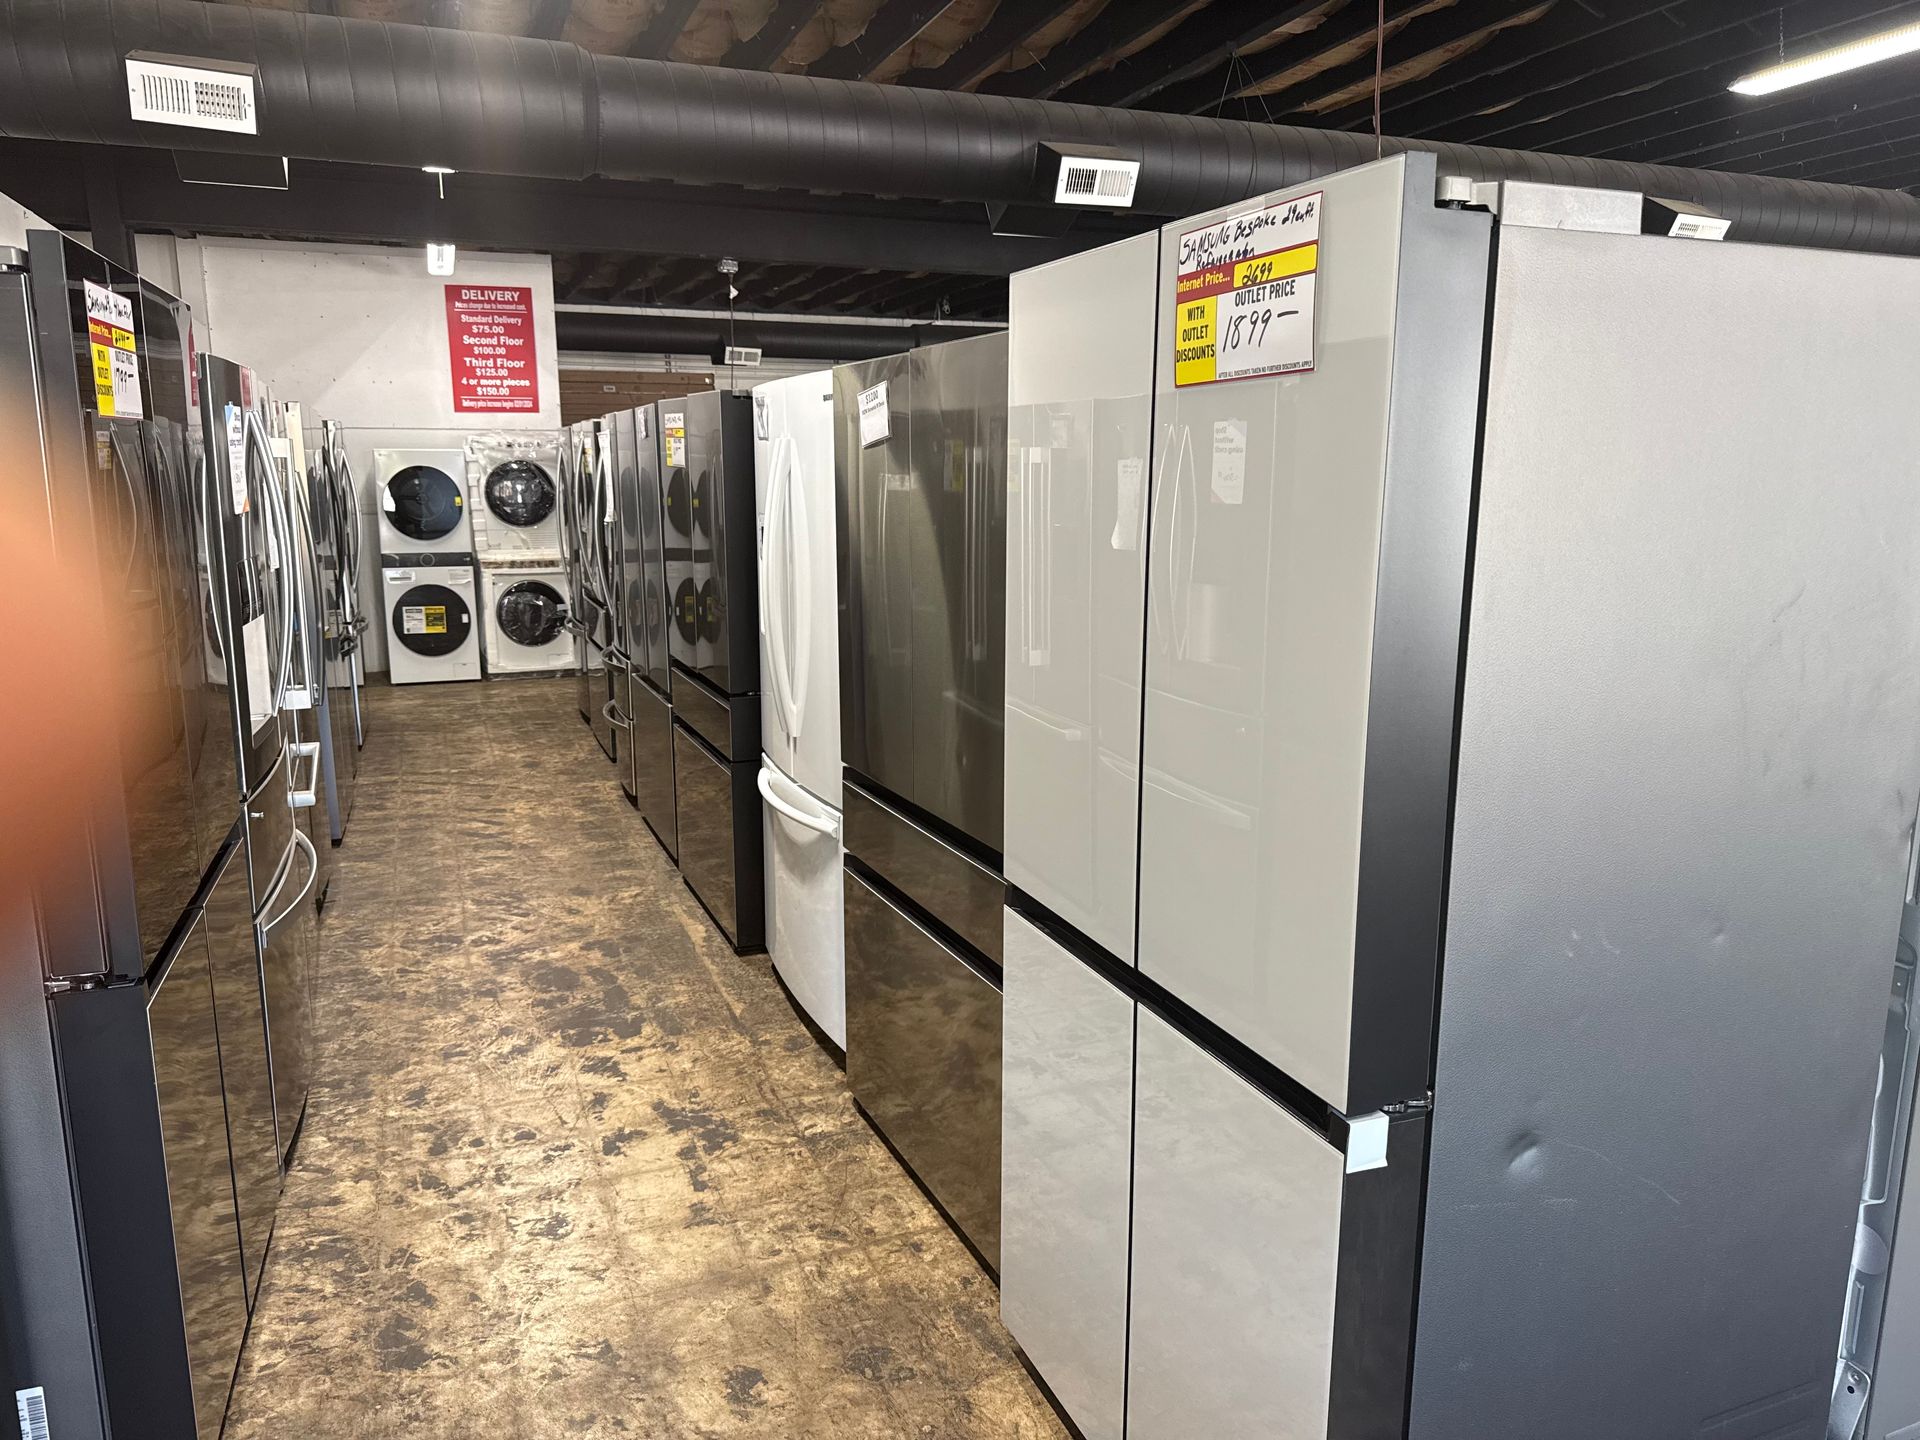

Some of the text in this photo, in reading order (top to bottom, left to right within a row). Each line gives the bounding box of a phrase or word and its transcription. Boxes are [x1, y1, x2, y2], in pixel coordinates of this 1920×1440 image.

[1180, 224, 1230, 266] SAMSUNG
[1234, 216, 1276, 242] Bespoke
[1178, 261, 1272, 293] Internet Price... 2699
[461, 290, 520, 301] DELIVERY
[1234, 280, 1296, 307] OUTLET PRICE
[1187, 305, 1205, 322] WITH
[461, 314, 522, 326] Standard Delivery
[472, 325, 504, 333] $75.00
[1182, 324, 1208, 342] OUTLET
[463, 335, 524, 346] Second Floor
[1176, 344, 1214, 363] DISCOUNTS
[464, 357, 525, 368] Third Floor
[98, 367, 109, 379] OUTLET
[476, 368, 508, 376] $125.00
[1234, 368, 1250, 376] DISCOUNTS
[1282, 362, 1300, 370] DISCOUNTS
[503, 378, 530, 387] pieces
[97, 384, 113, 397] DISCOUNTS
[477, 387, 510, 395] $150.00
